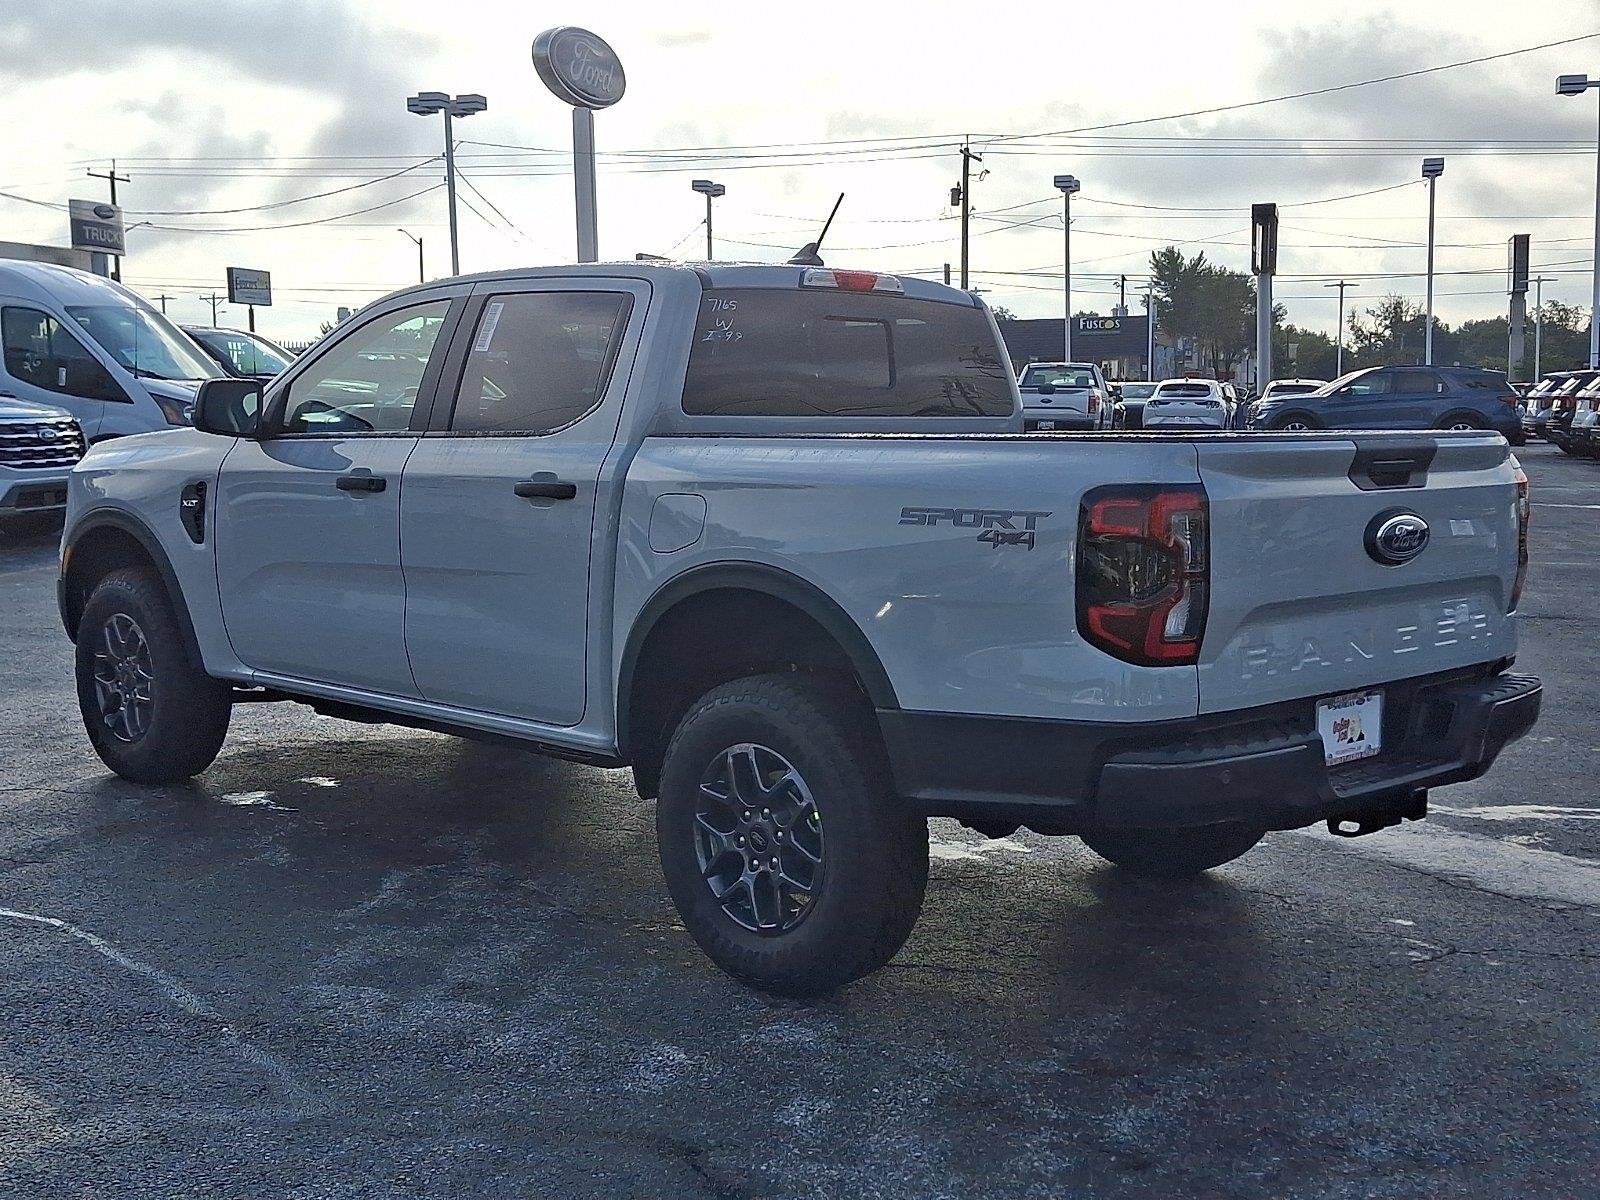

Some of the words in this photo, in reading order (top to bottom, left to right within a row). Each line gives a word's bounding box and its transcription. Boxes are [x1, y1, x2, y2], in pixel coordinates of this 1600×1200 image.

[570, 41, 614, 92] Ford
[182, 499, 198, 507] XLT
[898, 506, 1052, 530] SPORT
[1392, 525, 1420, 547] Ford
